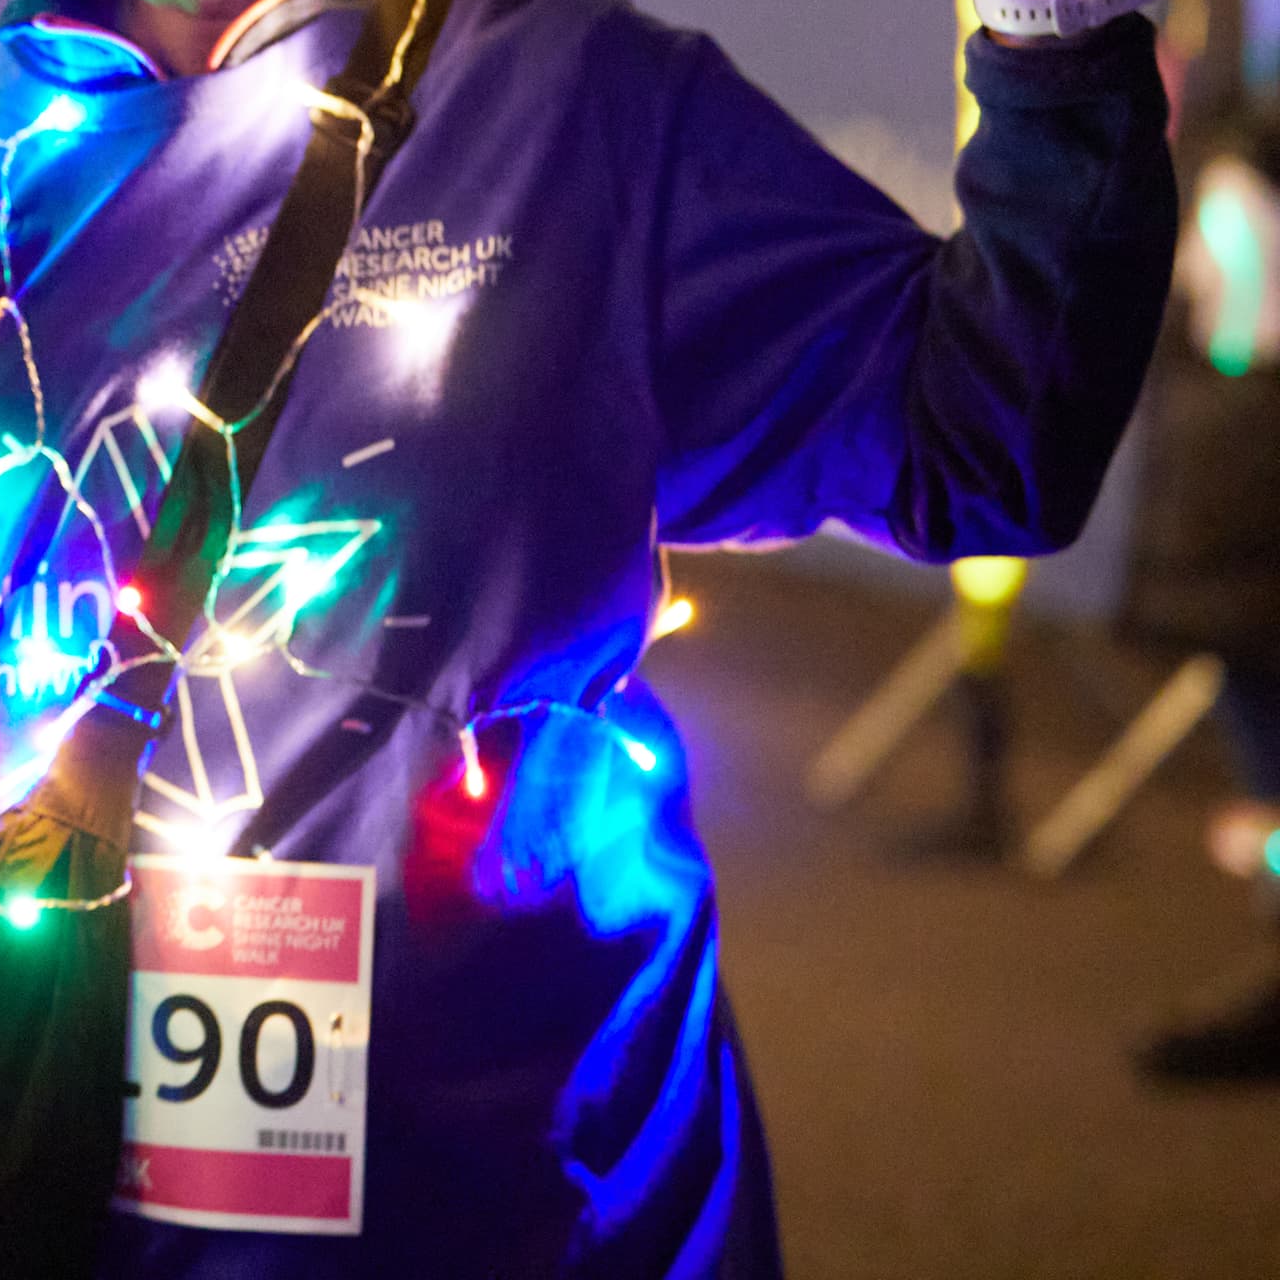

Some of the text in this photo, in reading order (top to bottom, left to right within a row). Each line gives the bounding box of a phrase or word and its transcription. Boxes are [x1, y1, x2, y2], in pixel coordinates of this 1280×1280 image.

[357, 220, 444, 250] ANCER
[475, 234, 513, 263] UK
[417, 264, 503, 299] NIGHT
[124, 994, 316, 1110] 90
